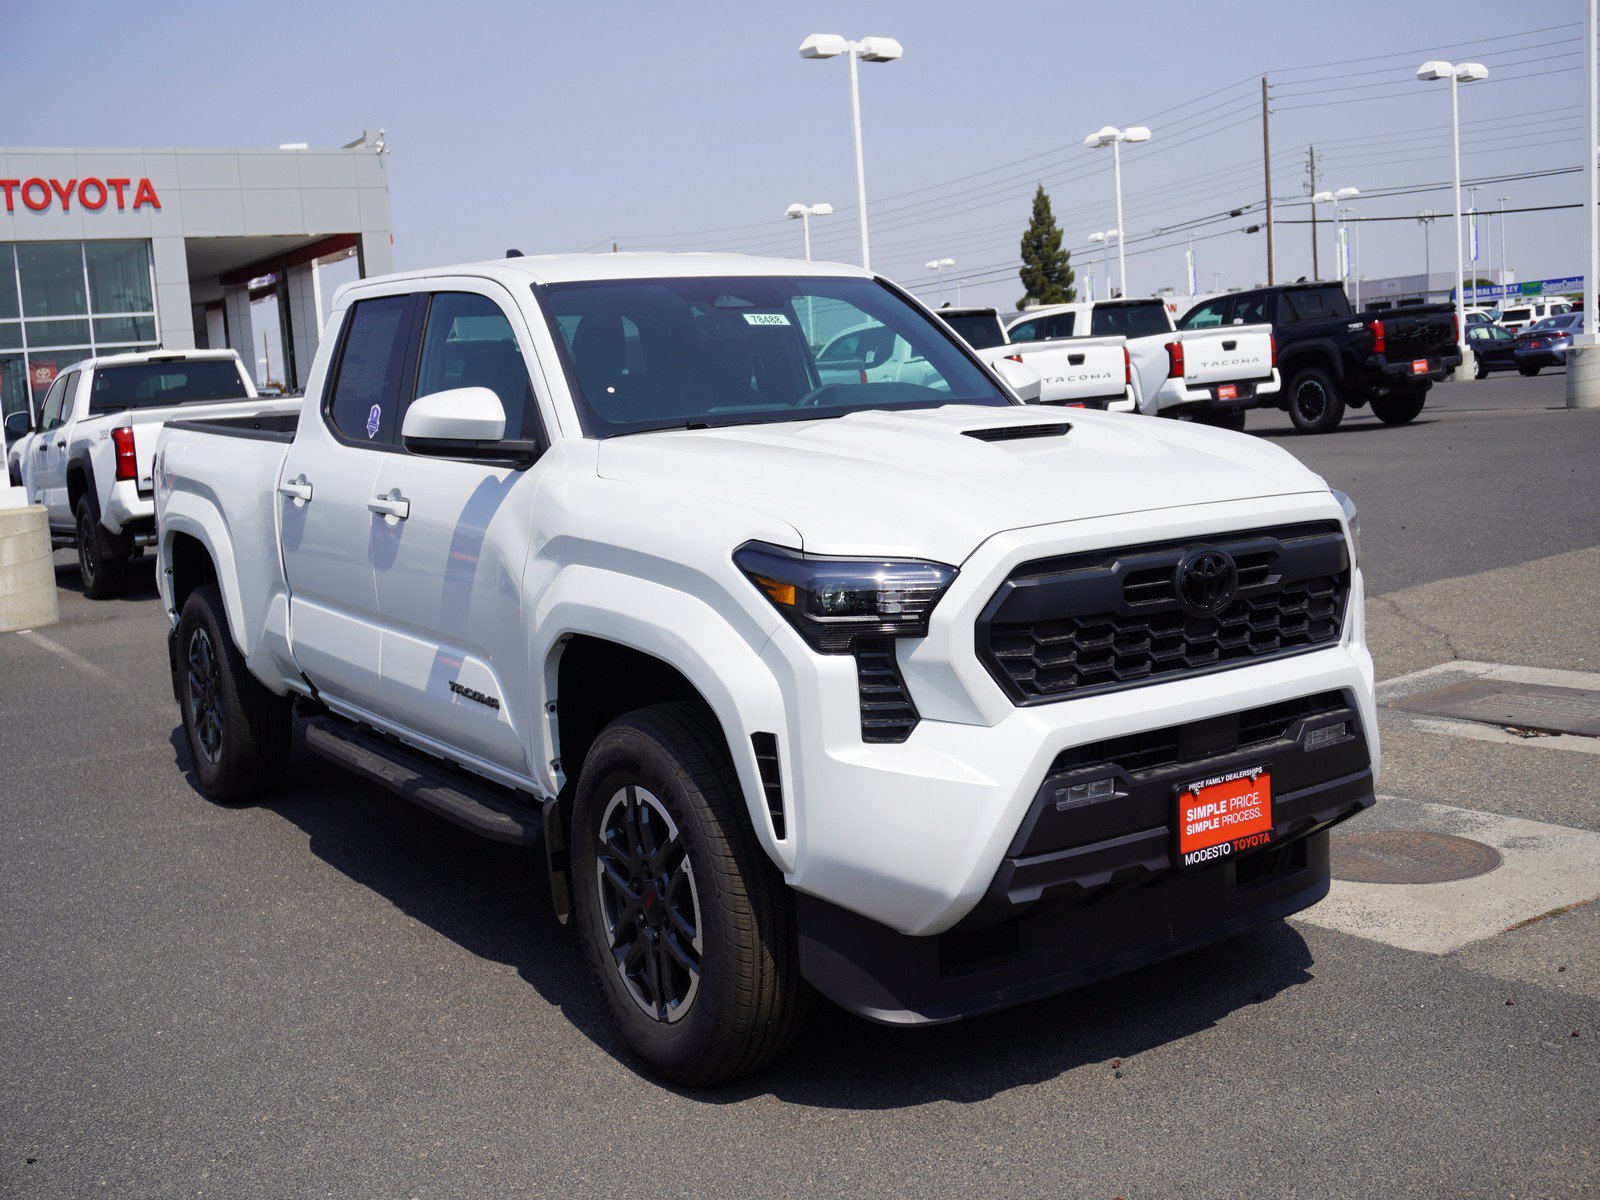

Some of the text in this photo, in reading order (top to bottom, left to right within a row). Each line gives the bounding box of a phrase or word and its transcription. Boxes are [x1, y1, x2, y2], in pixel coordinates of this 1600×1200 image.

[0, 178, 161, 211] TOYOTA
[750, 315, 783, 324] 78488
[1201, 357, 1260, 368] TACOMA
[1043, 373, 1111, 383] TACOMA
[449, 680, 500, 710] TACOMA
[1188, 766, 1263, 791] PRICE FAMILY DEALERSHIPS
[1186, 791, 1262, 823] SIMPLE PRICE.
[1186, 807, 1263, 836] SIMPLE PROCESS.
[1185, 832, 1271, 866] MODESTO TOYOTA
